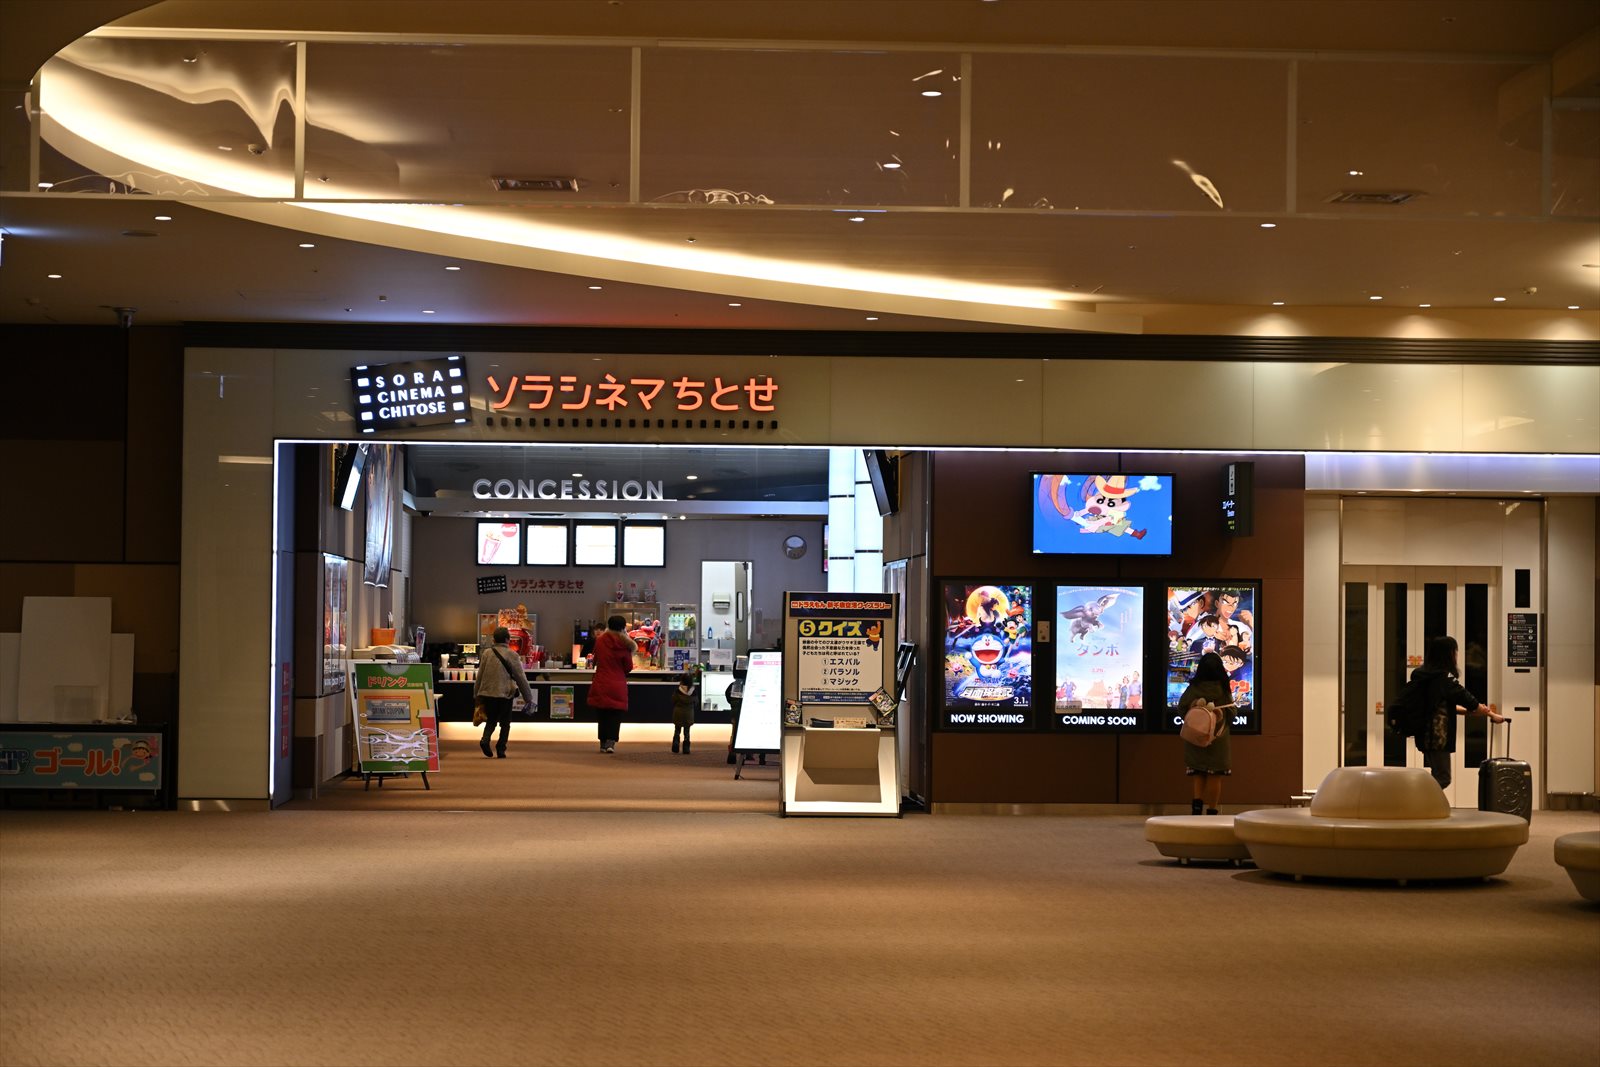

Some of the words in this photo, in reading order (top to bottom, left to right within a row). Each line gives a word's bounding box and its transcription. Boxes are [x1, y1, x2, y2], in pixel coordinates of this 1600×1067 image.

[375, 370, 444, 388] SORA
[377, 386, 446, 403] CINEMA
[486, 374, 779, 412] ソラシネマちとせ
[378, 399, 447, 420] CHITOSE
[472, 478, 665, 501] CONCESSION
[510, 579, 585, 590] ソラシネマちとせ
[818, 620, 862, 636] クイズ
[367, 676, 408, 688] ドリンク
[950, 714, 975, 724] NOW
[977, 714, 1025, 724] SHOWING
[1062, 715, 1106, 725] COMING
[1107, 716, 1137, 726] SOON
[1232, 716, 1247, 725] ON
[32, 746, 122, 778] ゴール!
